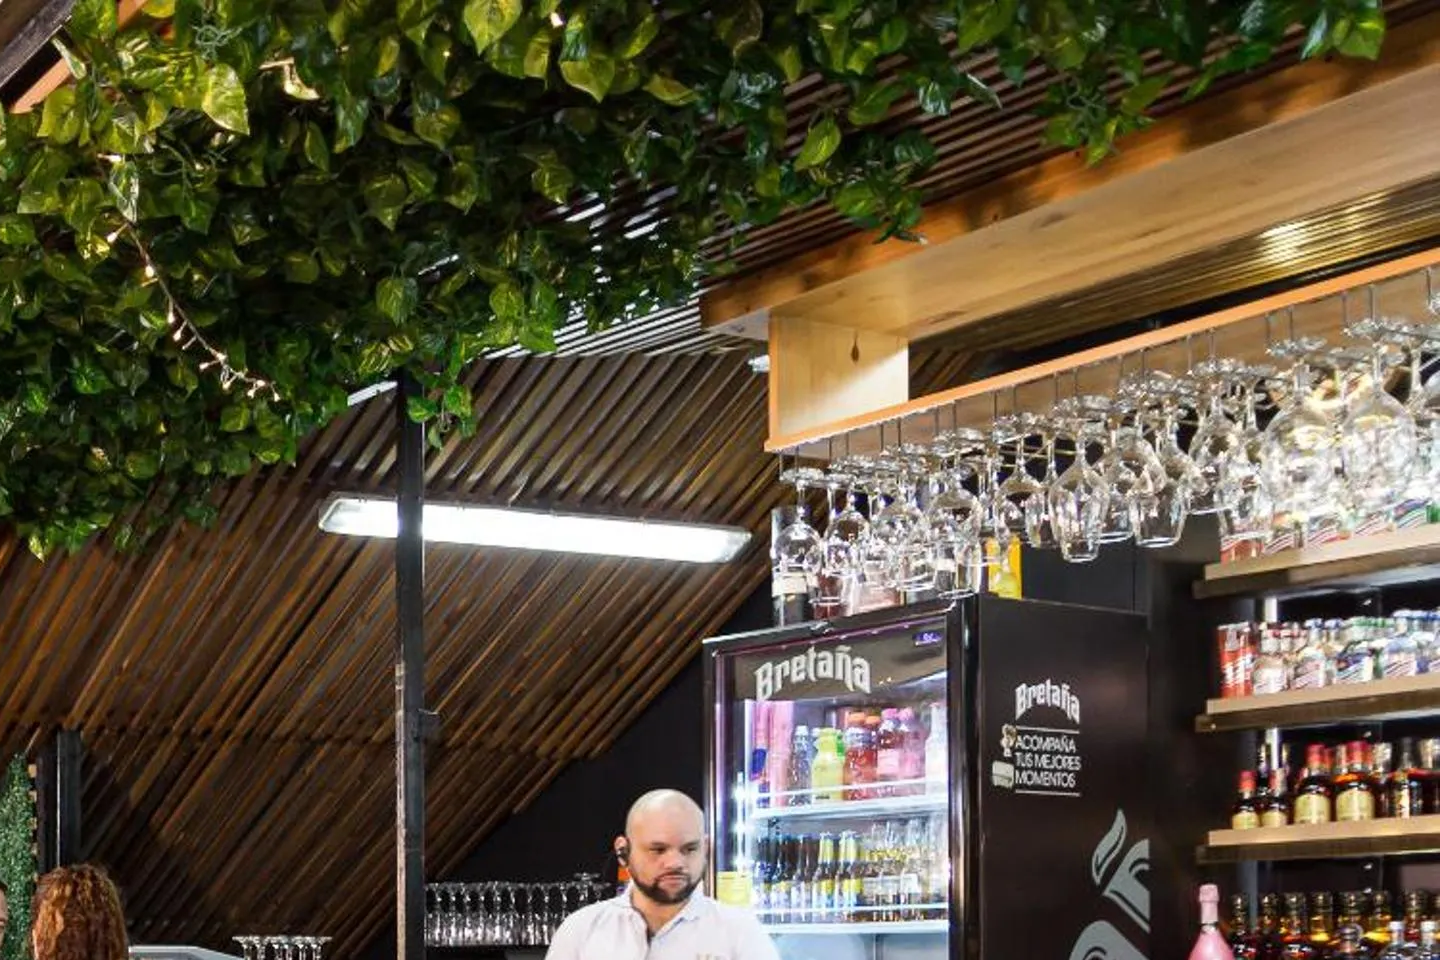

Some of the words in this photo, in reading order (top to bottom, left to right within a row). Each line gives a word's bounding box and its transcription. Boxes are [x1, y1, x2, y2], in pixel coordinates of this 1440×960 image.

[754, 645, 872, 701] Bretaña
[1015, 679, 1080, 724] Bretaña
[1015, 735, 1077, 753] ACOMPAÑA
[1015, 752, 1033, 768] TUS
[1015, 770, 1077, 788] MOMENTOS
